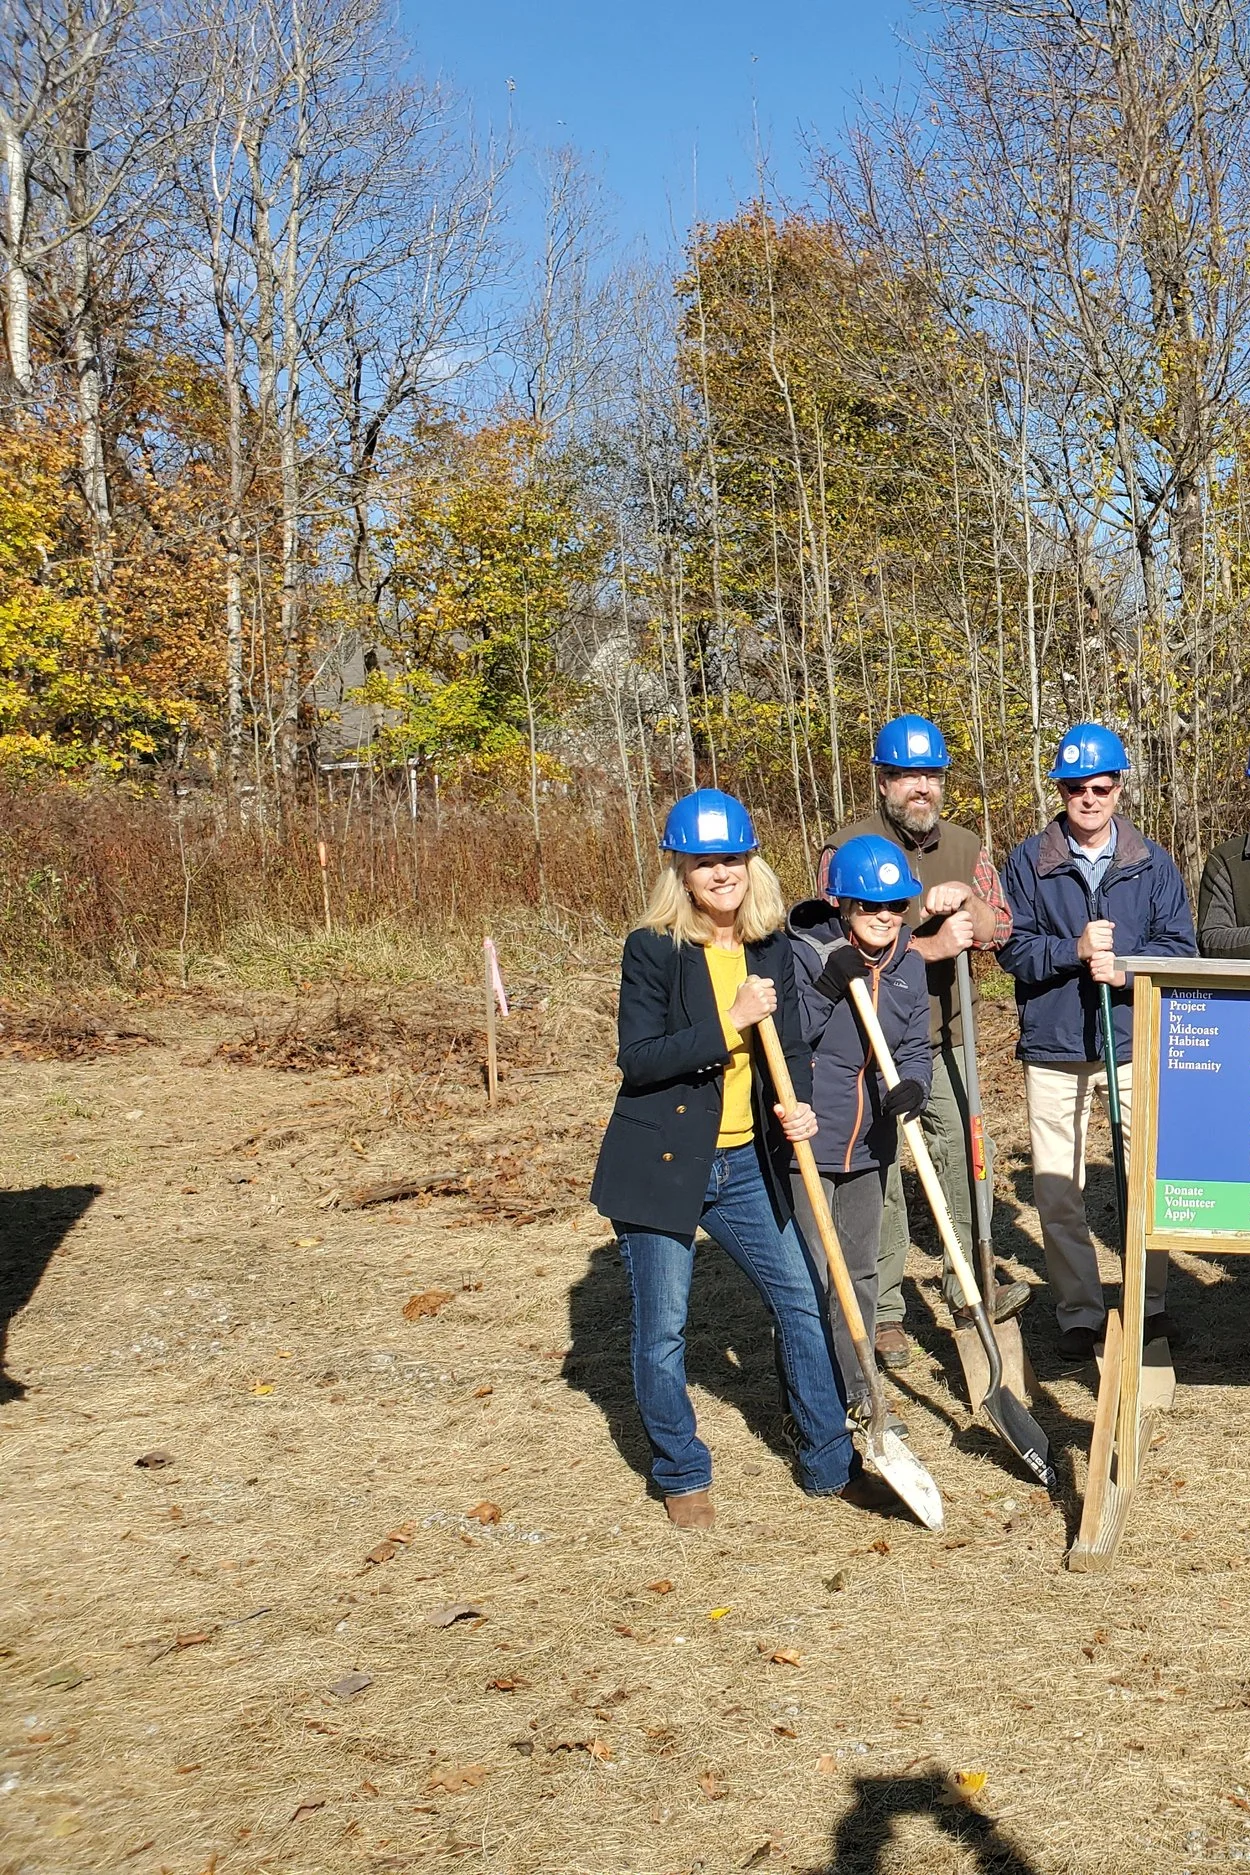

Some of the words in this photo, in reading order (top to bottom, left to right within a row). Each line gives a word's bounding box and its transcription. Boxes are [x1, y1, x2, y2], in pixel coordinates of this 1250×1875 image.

[1170, 988, 1214, 1000] Another
[1169, 1000, 1207, 1013] Project
[1169, 1011, 1183, 1024] by
[1169, 1023, 1219, 1036] Midcoast
[1168, 1035, 1210, 1047] Habitat
[1168, 1047, 1185, 1058] for
[1167, 1058, 1222, 1073] Humanity
[1164, 1184, 1204, 1196] Donate
[1164, 1196, 1216, 1208] Volunteer
[1164, 1207, 1197, 1222] Apply
